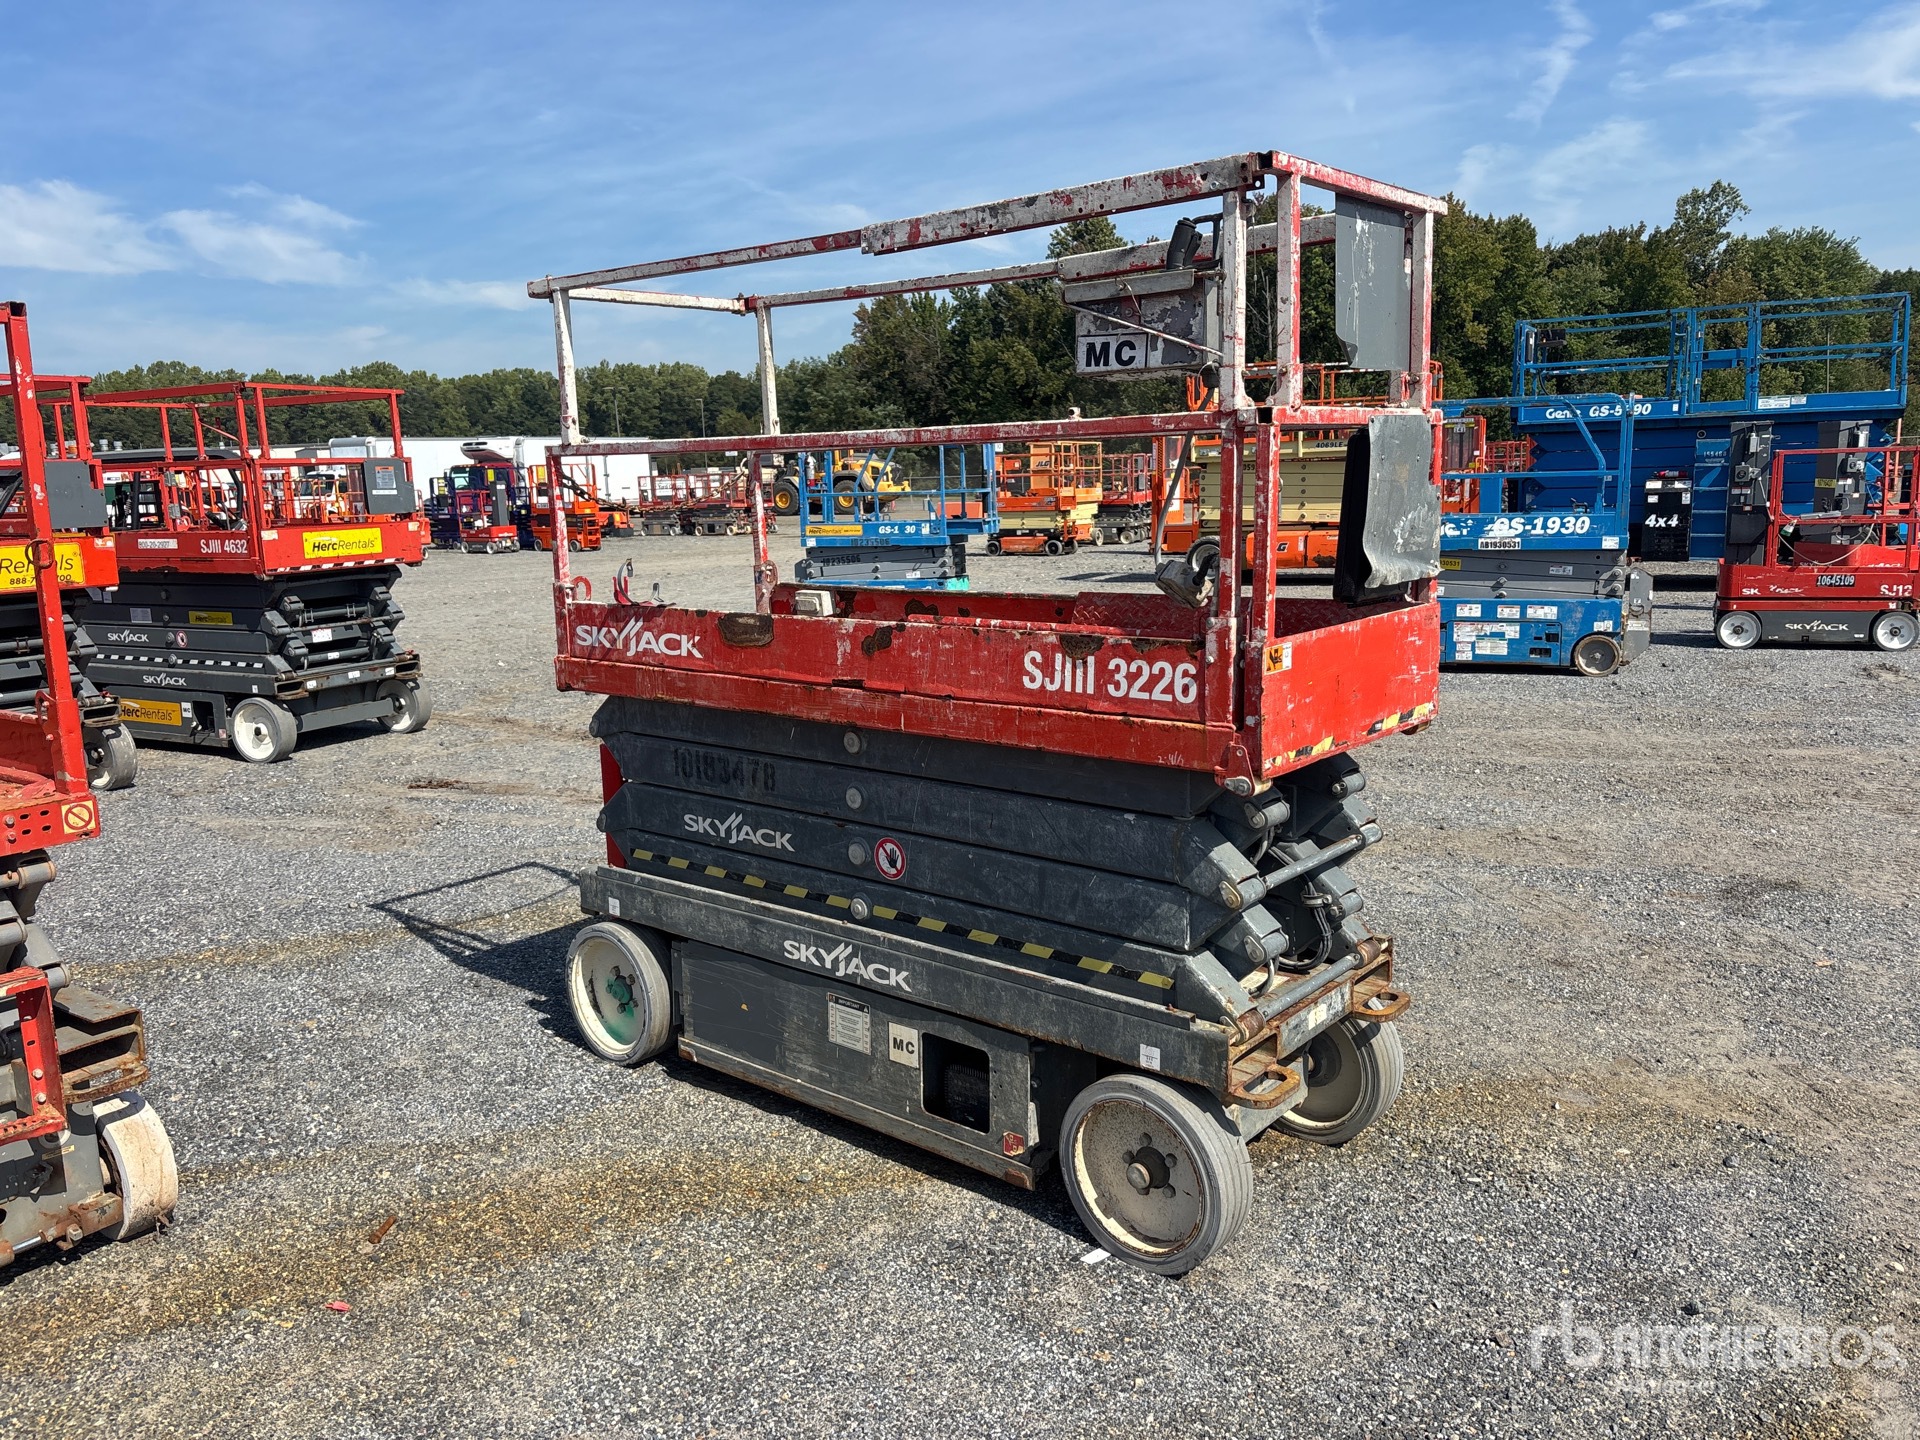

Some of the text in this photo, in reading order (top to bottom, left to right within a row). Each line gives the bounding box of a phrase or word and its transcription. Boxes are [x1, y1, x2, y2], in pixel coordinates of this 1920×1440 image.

[1085, 340, 1137, 367] MC
[1589, 403, 1652, 417] GS-590
[1644, 514, 1679, 527] 4x4
[223, 539, 248, 553] 4632
[312, 540, 375, 552] HercRentals
[1480, 541, 1520, 549] AB1930531
[1816, 575, 1855, 585] 10645109
[1784, 619, 1849, 632] SKYJACK
[107, 629, 149, 643] SKYJACK
[575, 615, 704, 659] SKYJACK
[142, 672, 187, 686] SKYJACK
[1107, 657, 1198, 704] 3226
[683, 811, 795, 852] SKYJACK
[783, 940, 912, 993] SKYJACK
[892, 1036, 915, 1055] MC
